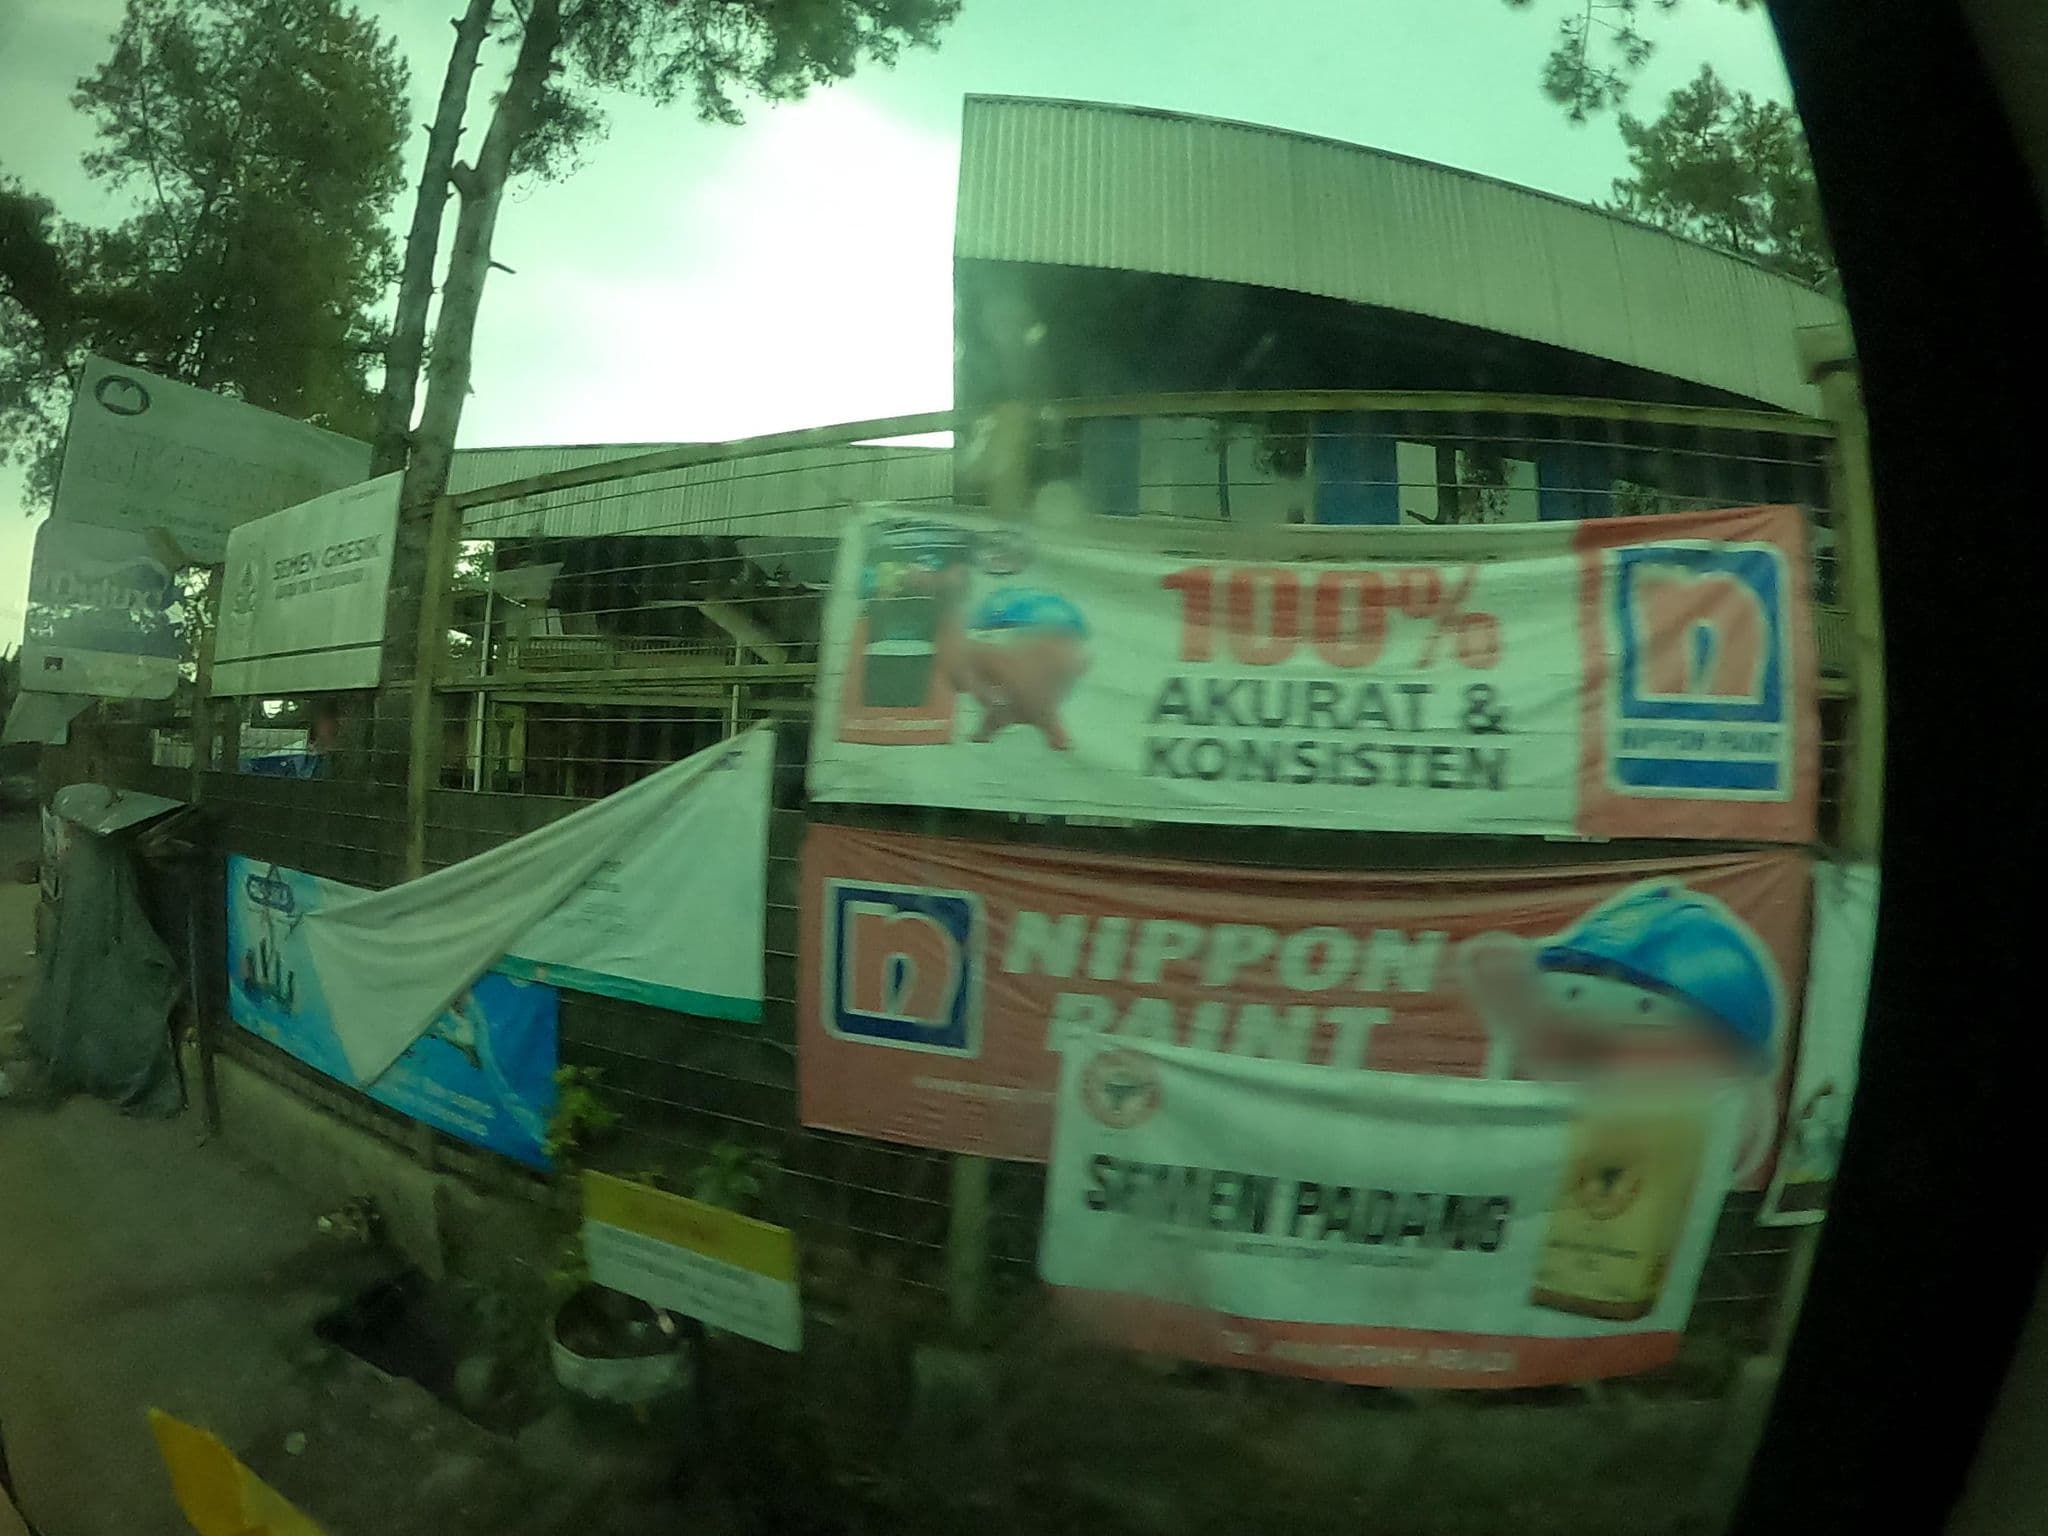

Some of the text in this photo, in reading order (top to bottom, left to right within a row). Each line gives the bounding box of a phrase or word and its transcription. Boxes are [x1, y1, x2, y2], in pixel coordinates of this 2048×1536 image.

[1160, 564, 1502, 670] 100%
[1152, 677, 1508, 735] AKURAT &
[1142, 736, 1508, 791] KONSISTEN
[1003, 911, 1449, 992] NIPPON
[1046, 993, 1394, 1069] PAINT
[1087, 1153, 1268, 1236] SEMEN
[1292, 1180, 1512, 1252] PADANG
